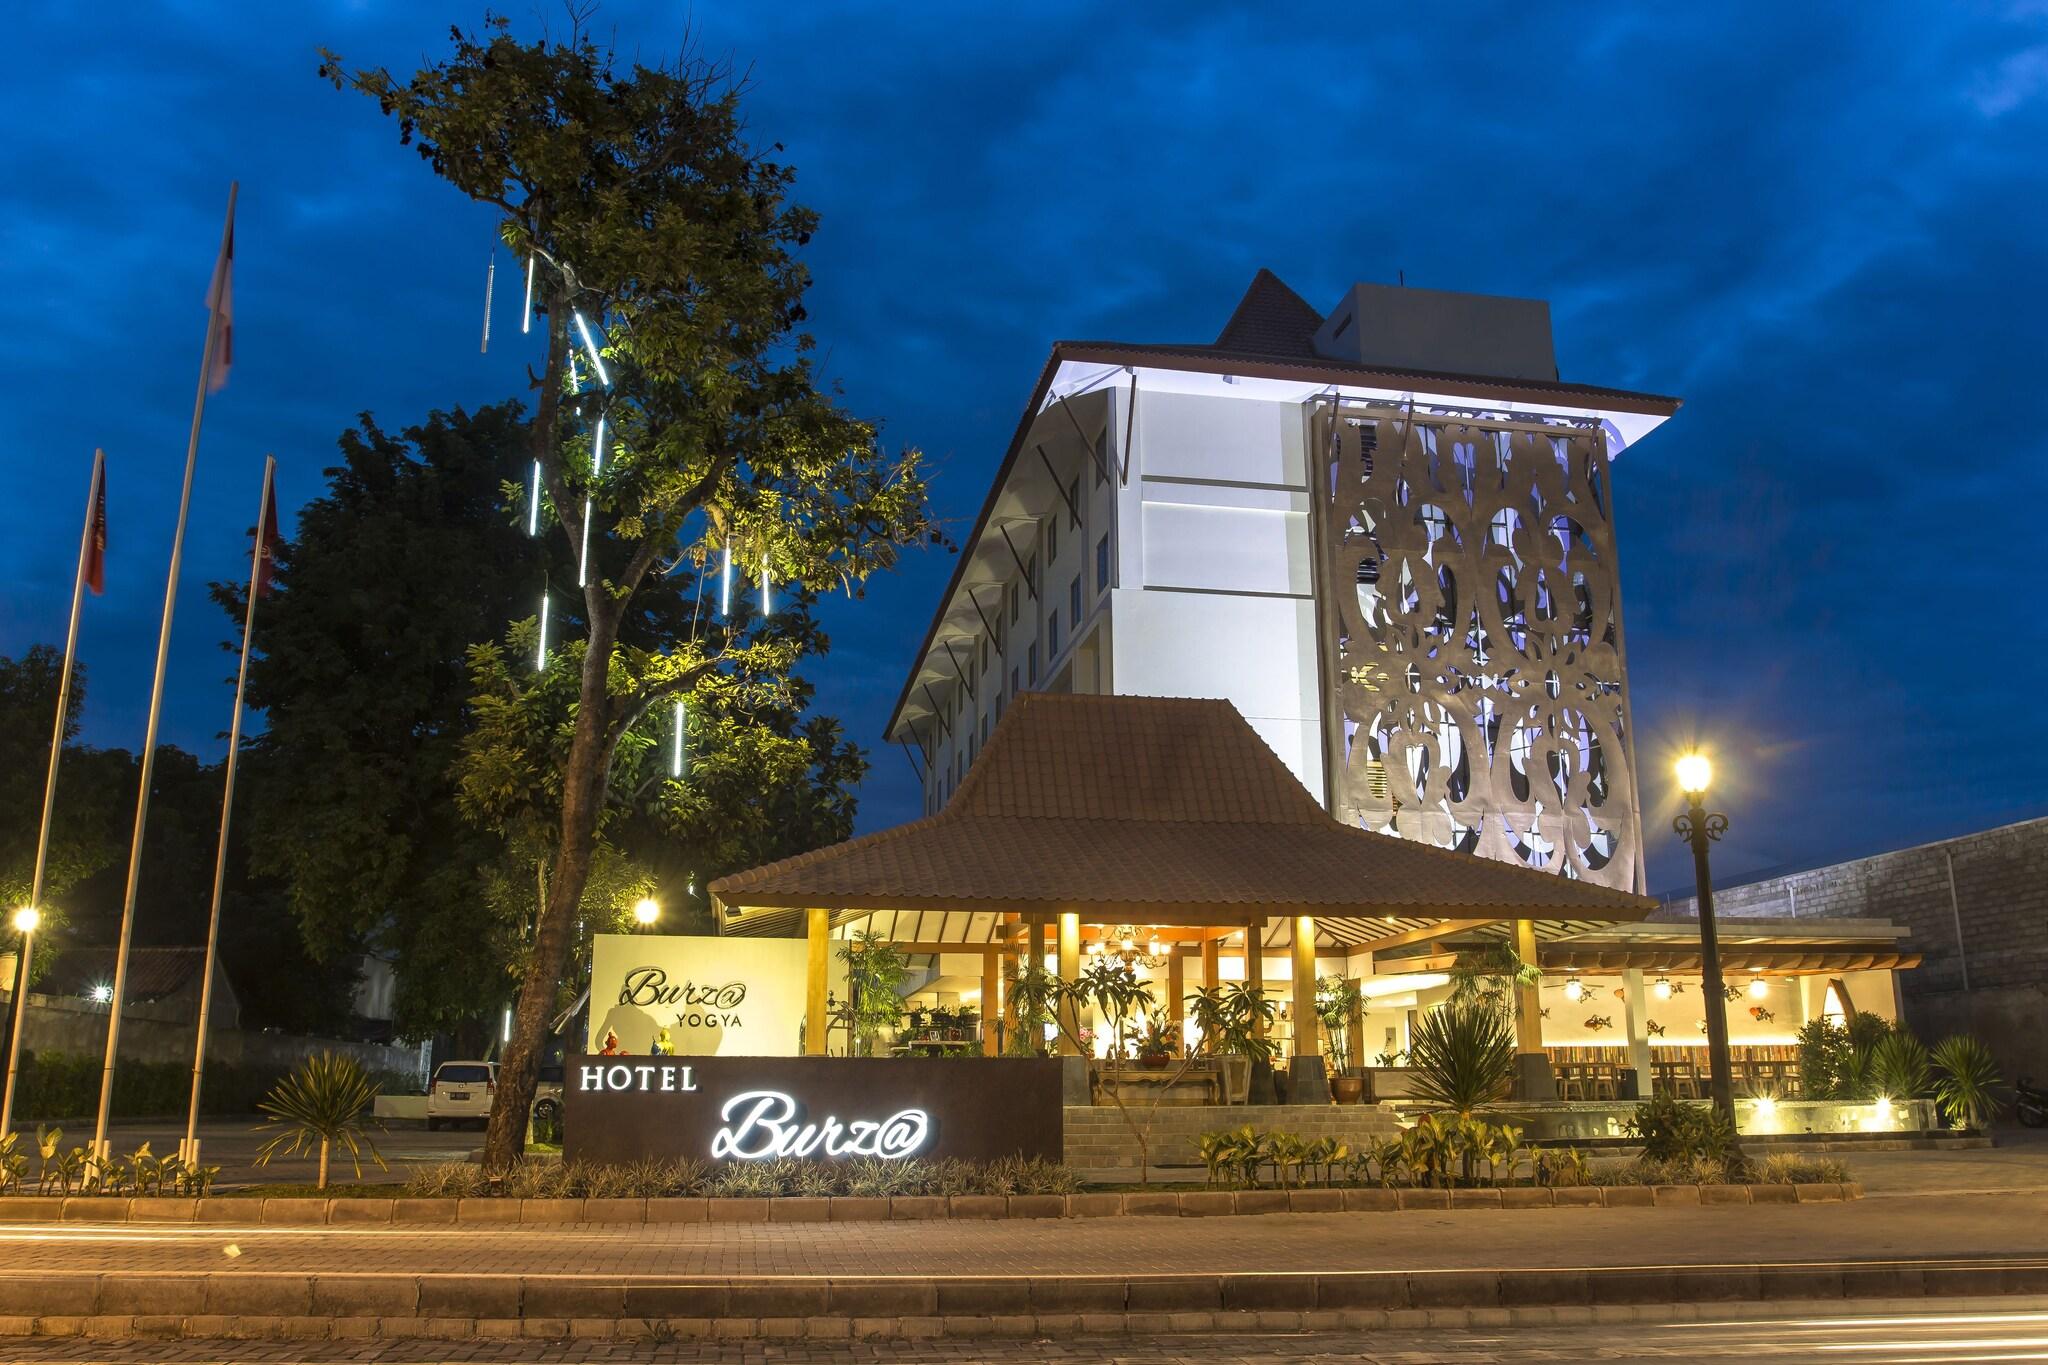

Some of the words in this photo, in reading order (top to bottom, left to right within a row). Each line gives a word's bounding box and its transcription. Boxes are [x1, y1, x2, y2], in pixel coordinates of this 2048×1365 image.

[619, 968, 746, 1009] Burz@
[676, 1013, 742, 1028] YOGYA
[580, 1066, 697, 1091] HOTEL
[711, 1091, 928, 1159] Burz@
